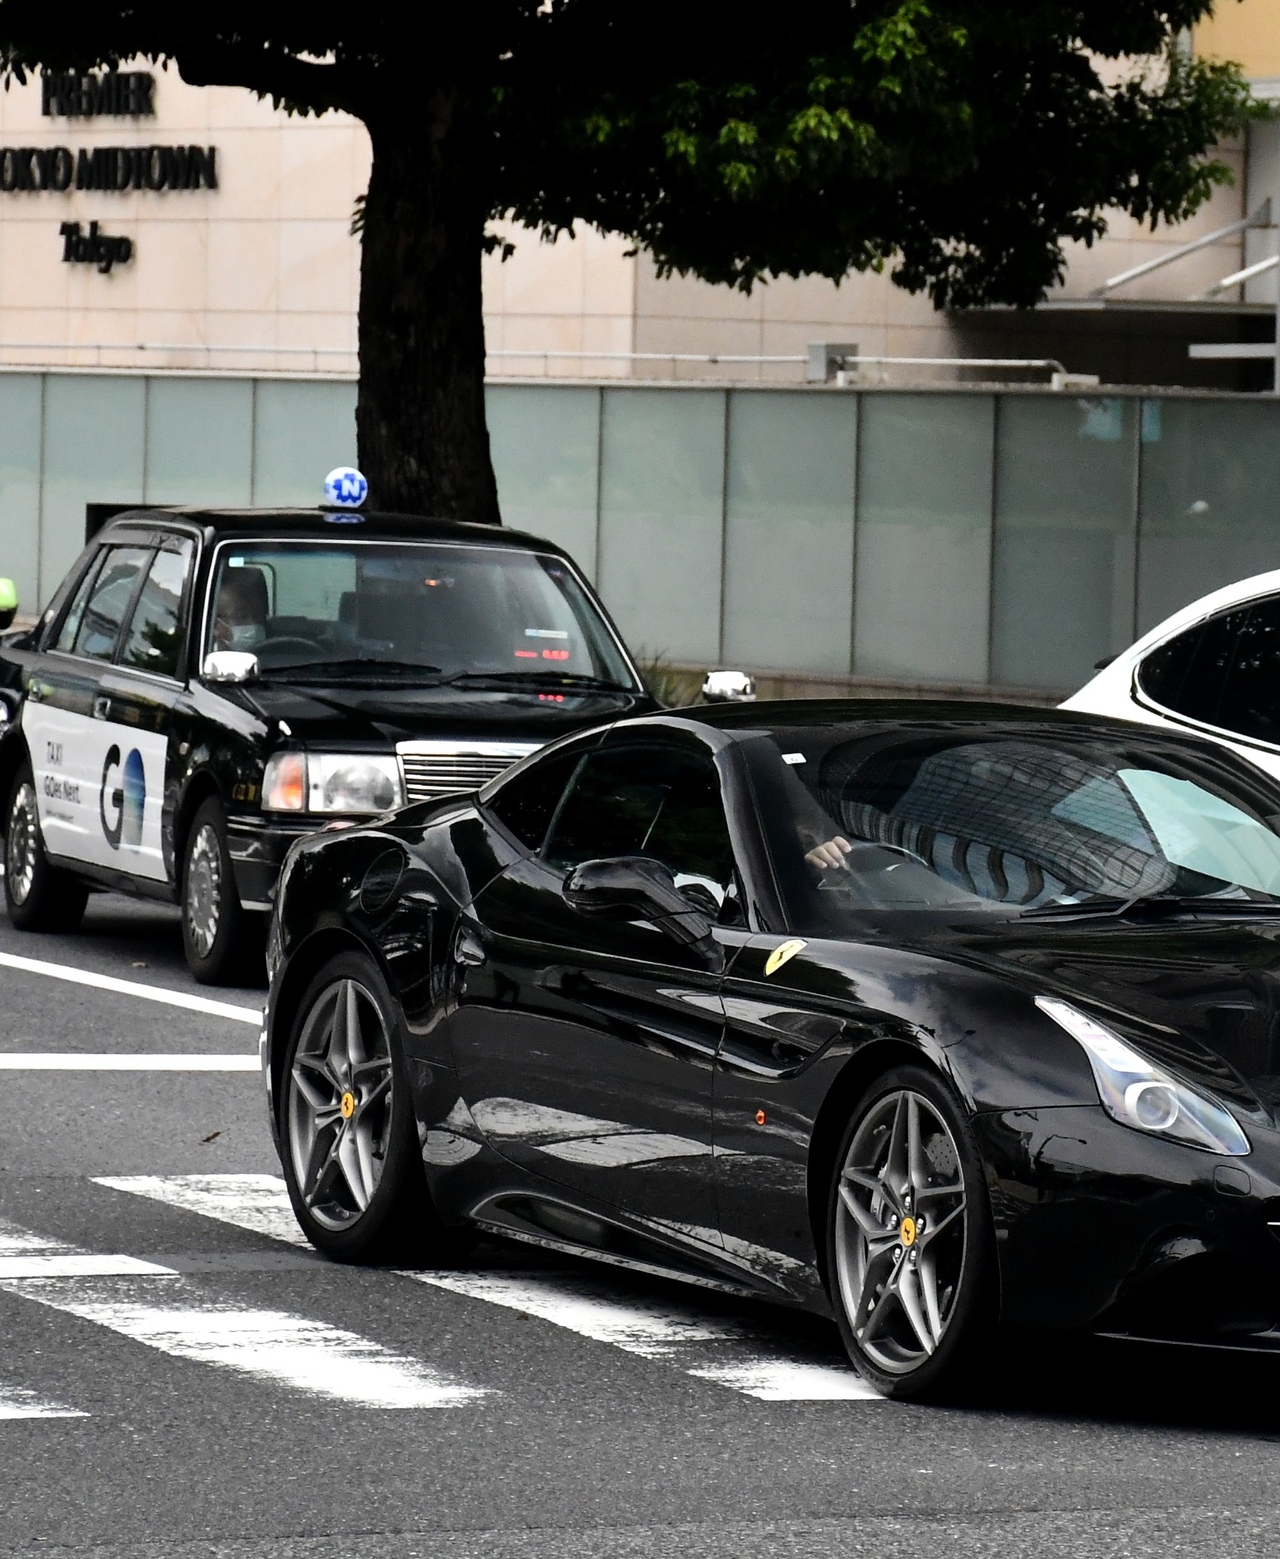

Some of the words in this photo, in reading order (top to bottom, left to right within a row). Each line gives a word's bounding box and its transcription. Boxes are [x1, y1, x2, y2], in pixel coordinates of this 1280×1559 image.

[41, 72, 155, 117] PREMIER
[76, 146, 217, 190] MIDTOWN
[60, 220, 133, 274] Tokyo
[341, 479, 360, 497] N
